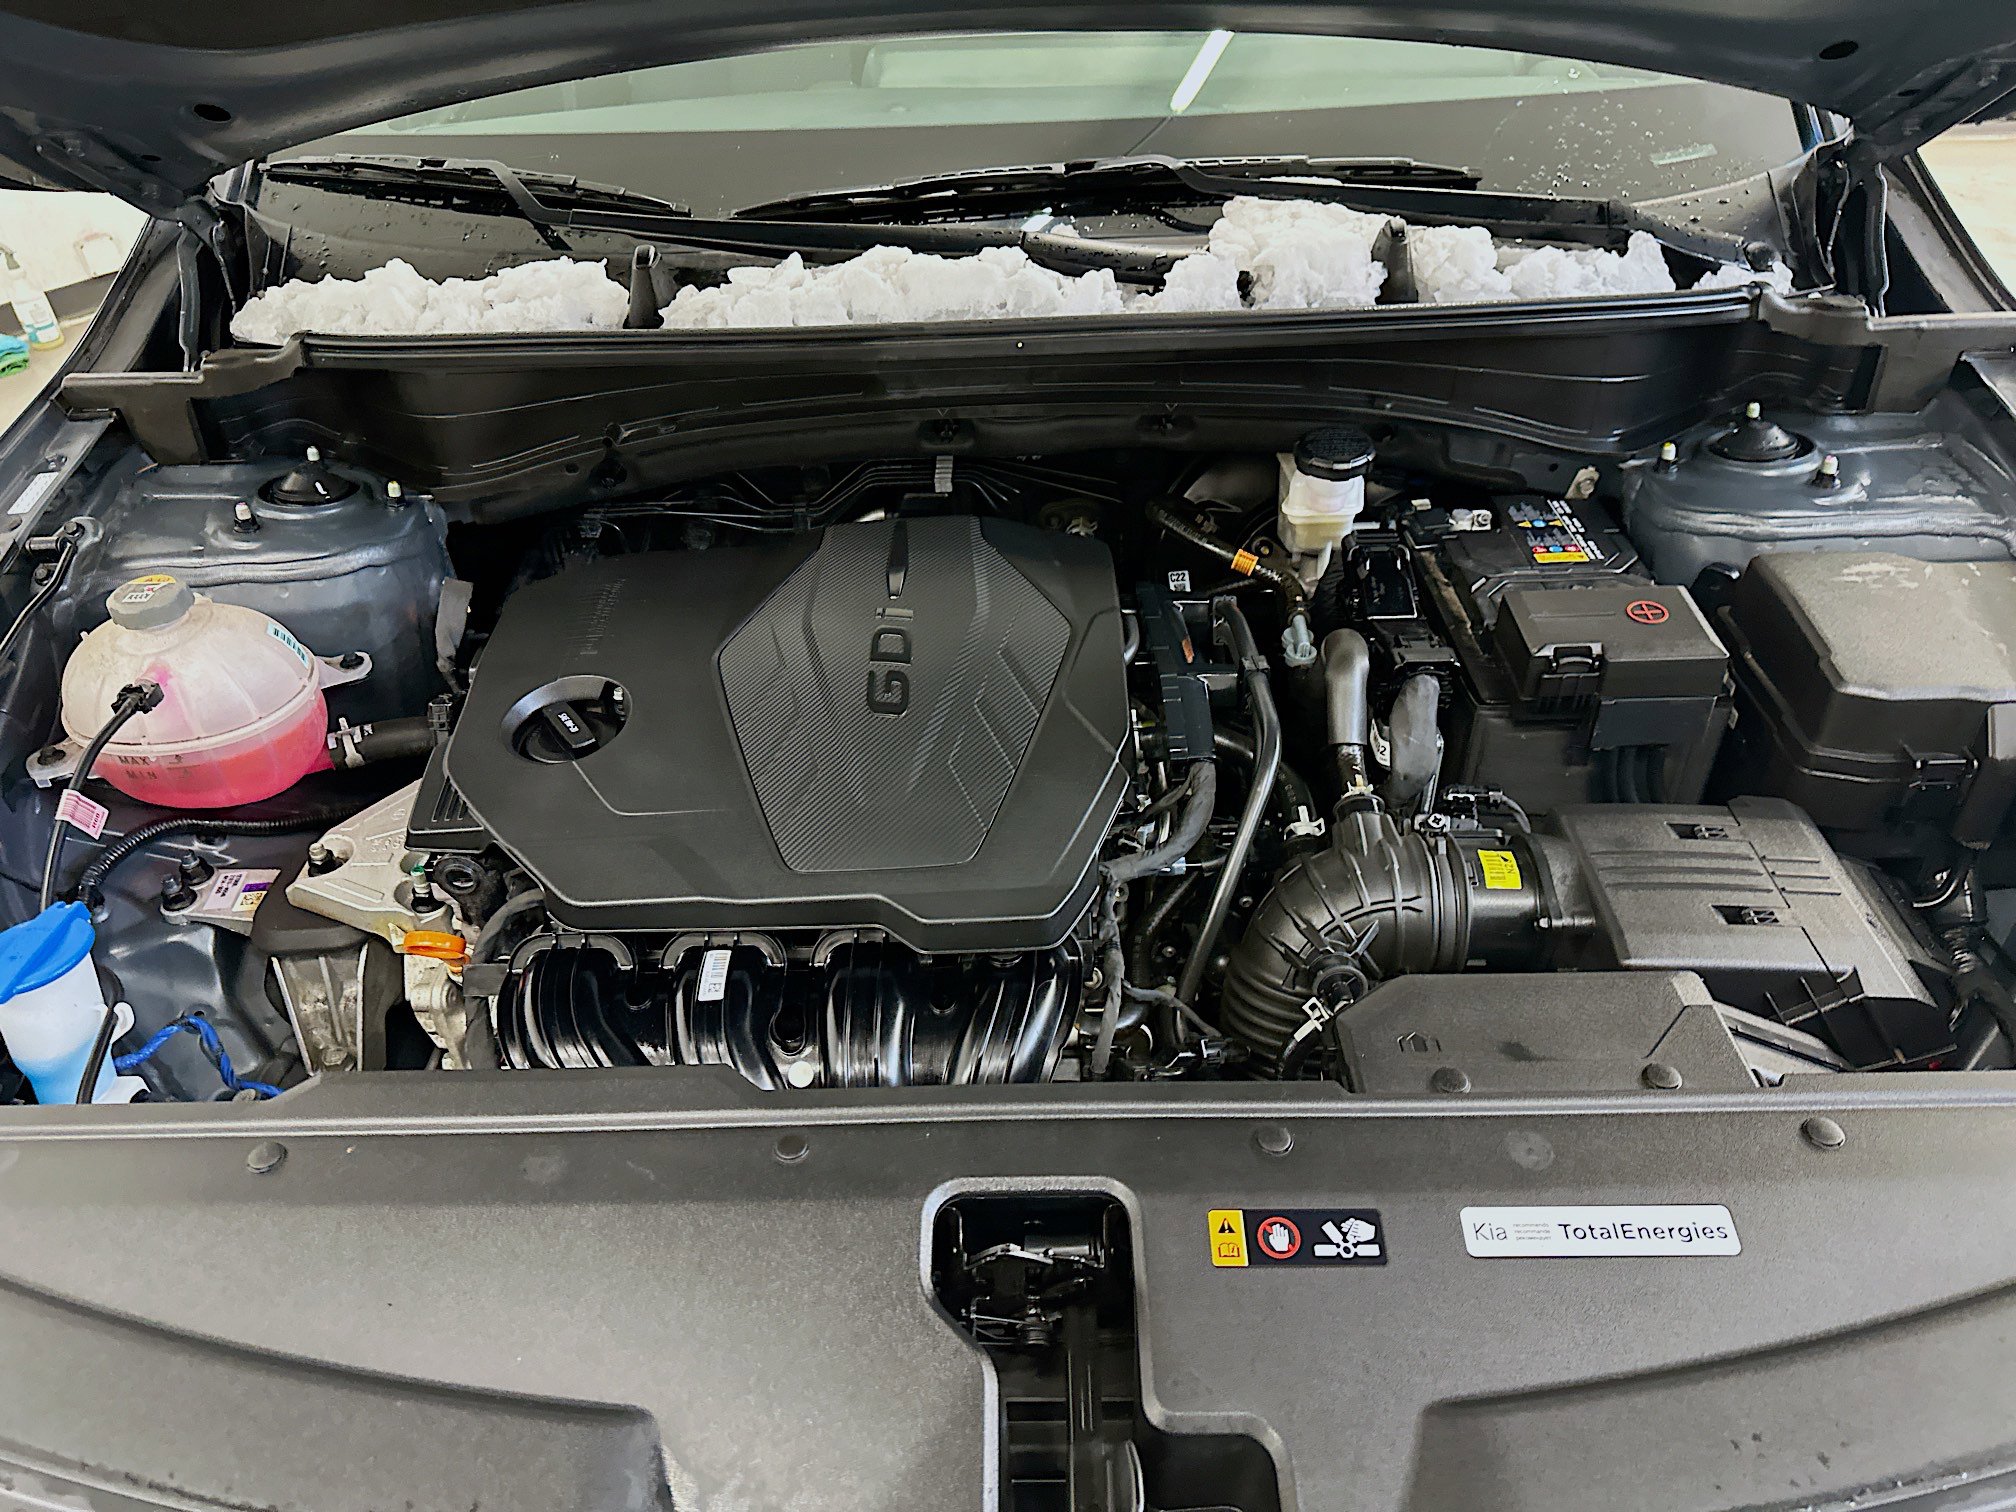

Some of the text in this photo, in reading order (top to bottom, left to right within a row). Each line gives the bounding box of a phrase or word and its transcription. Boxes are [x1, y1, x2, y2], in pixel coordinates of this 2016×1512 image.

[1170, 572, 1186, 583] C22
[867, 607, 914, 719] GDi
[118, 755, 150, 766] MAX
[126, 770, 158, 780] MIN
[1473, 1221, 1729, 1243] Kia TotalEnergies
